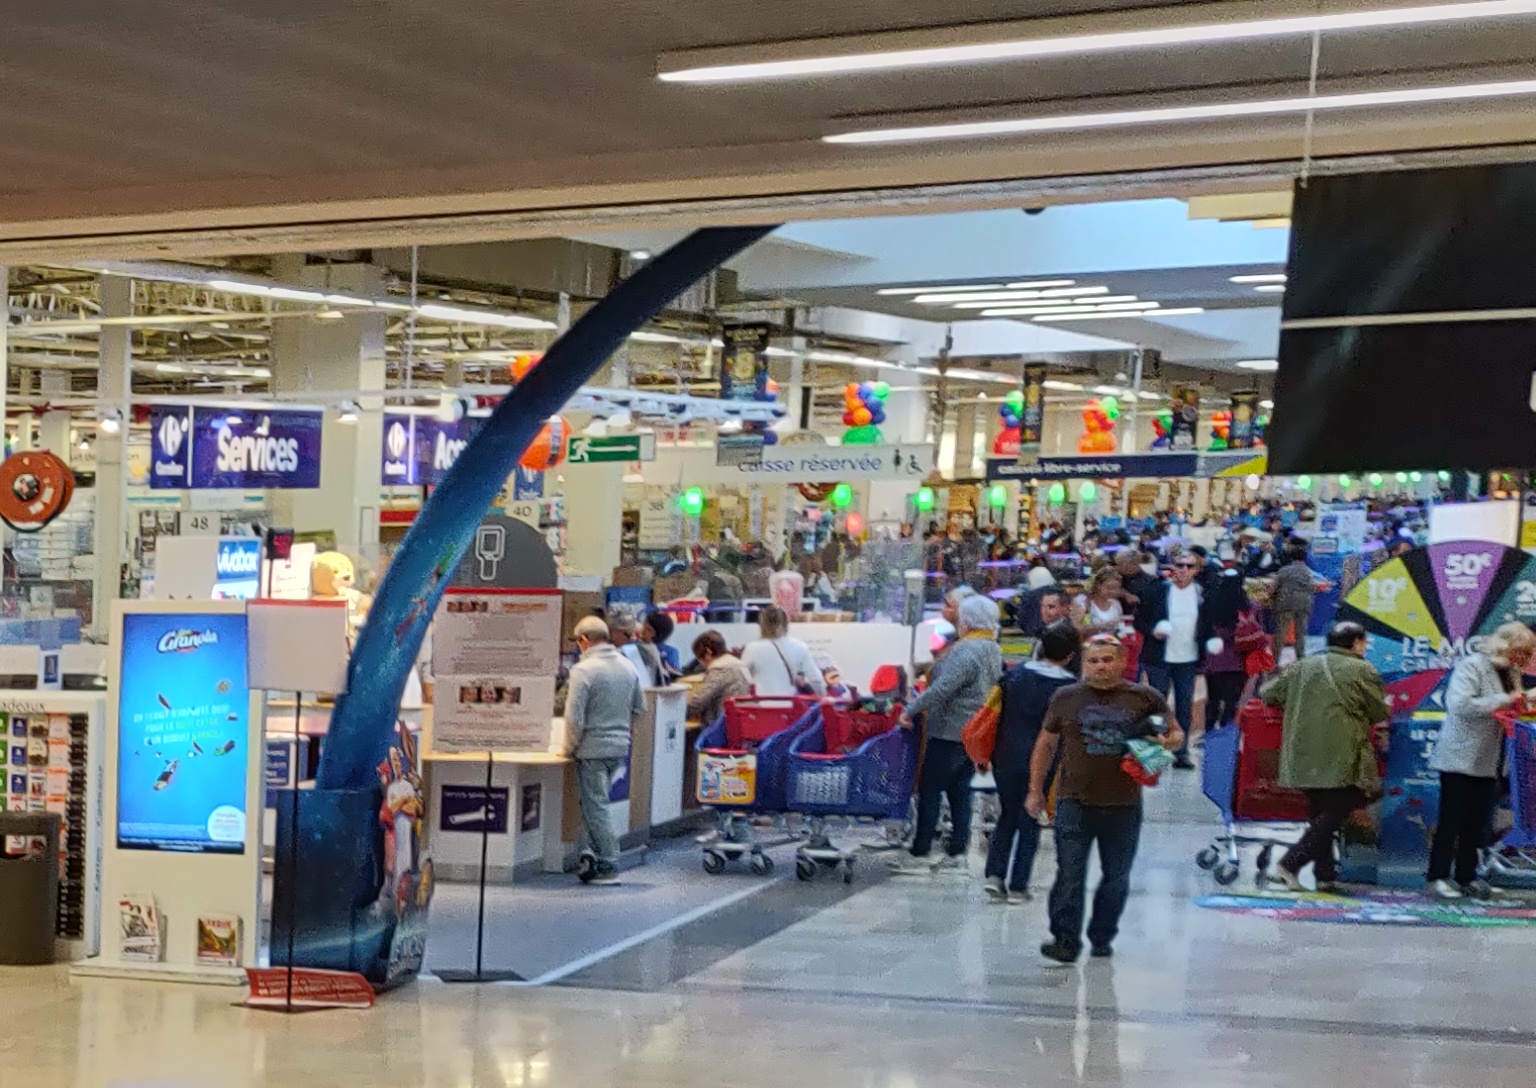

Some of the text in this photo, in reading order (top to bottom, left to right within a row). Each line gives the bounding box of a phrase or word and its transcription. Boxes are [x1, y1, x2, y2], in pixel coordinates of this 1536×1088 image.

[217, 426, 299, 473] Services
[800, 452, 882, 472] réservée
[190, 516, 210, 530] 48
[157, 629, 219, 652] Granola
